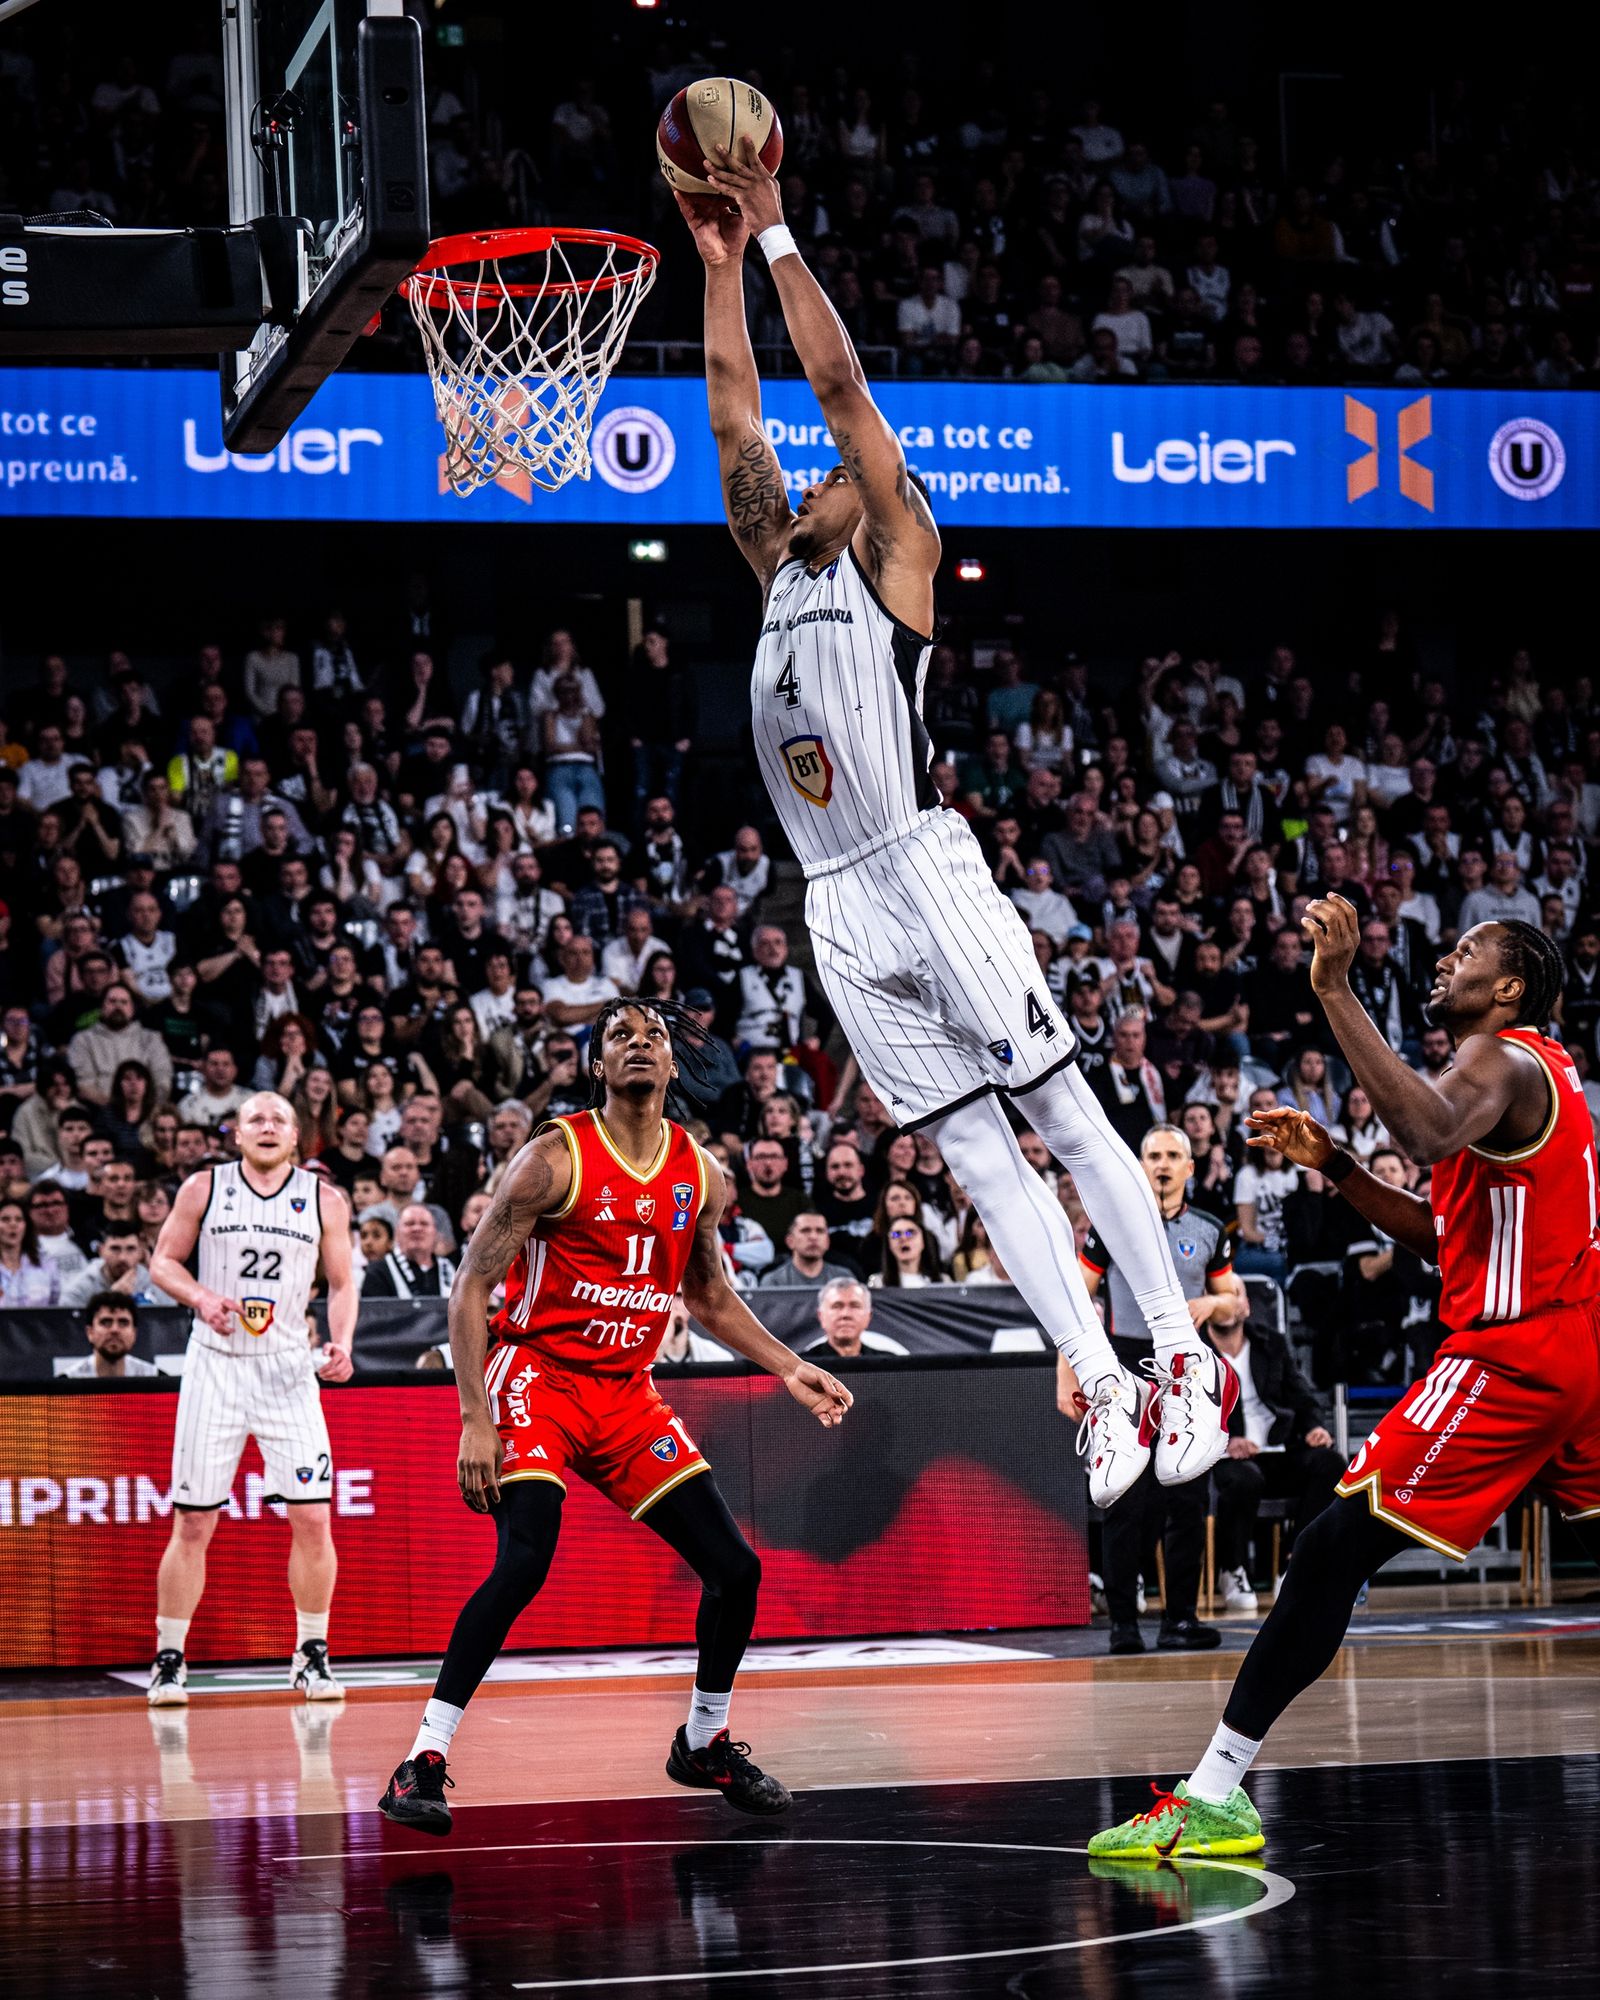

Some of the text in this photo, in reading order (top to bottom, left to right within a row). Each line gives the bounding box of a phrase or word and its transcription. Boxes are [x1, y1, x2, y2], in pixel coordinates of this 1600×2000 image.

[2, 411, 97, 437] tot ce
[764, 418, 1033, 449] Dura ca tot ce
[0, 454, 138, 488] preună.
[615, 432, 650, 473] U
[1111, 431, 1296, 484] Leier
[1509, 442, 1543, 481] U
[906, 464, 1070, 501] mpreună.
[774, 651, 801, 710] 4
[792, 750, 819, 778] BT
[1024, 987, 1058, 1043] 4
[240, 1248, 281, 1280] 22
[621, 1234, 656, 1276] 11
[247, 1306, 268, 1319] BT
[582, 1316, 651, 1349] mts
[1406, 1370, 1490, 1486] W.D. CONCORD WEST
